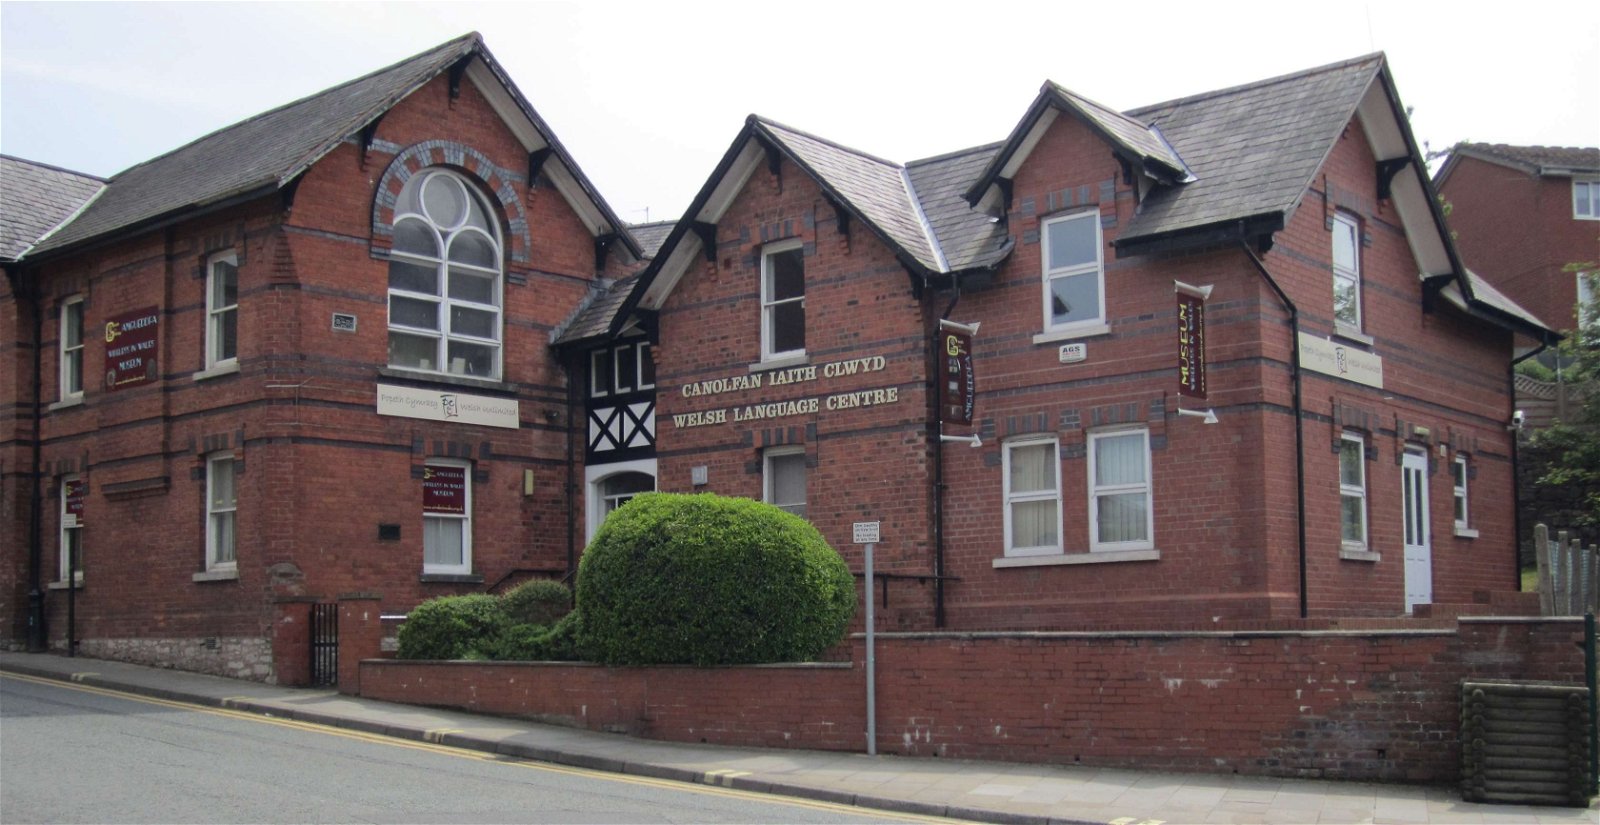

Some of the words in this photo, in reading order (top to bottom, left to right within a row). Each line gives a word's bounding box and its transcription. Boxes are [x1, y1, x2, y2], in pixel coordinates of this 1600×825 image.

[119, 358, 141, 370] MUSEUM
[1062, 345, 1081, 353] AGS
[1179, 303, 1190, 386] MUSEUM
[681, 373, 763, 398] CANOLFAN
[768, 365, 817, 386] IAITH
[823, 355, 887, 378] CLWYD
[672, 409, 727, 429] WELSH
[733, 398, 819, 422] LANGUAGE
[826, 387, 899, 411] CENTRE
